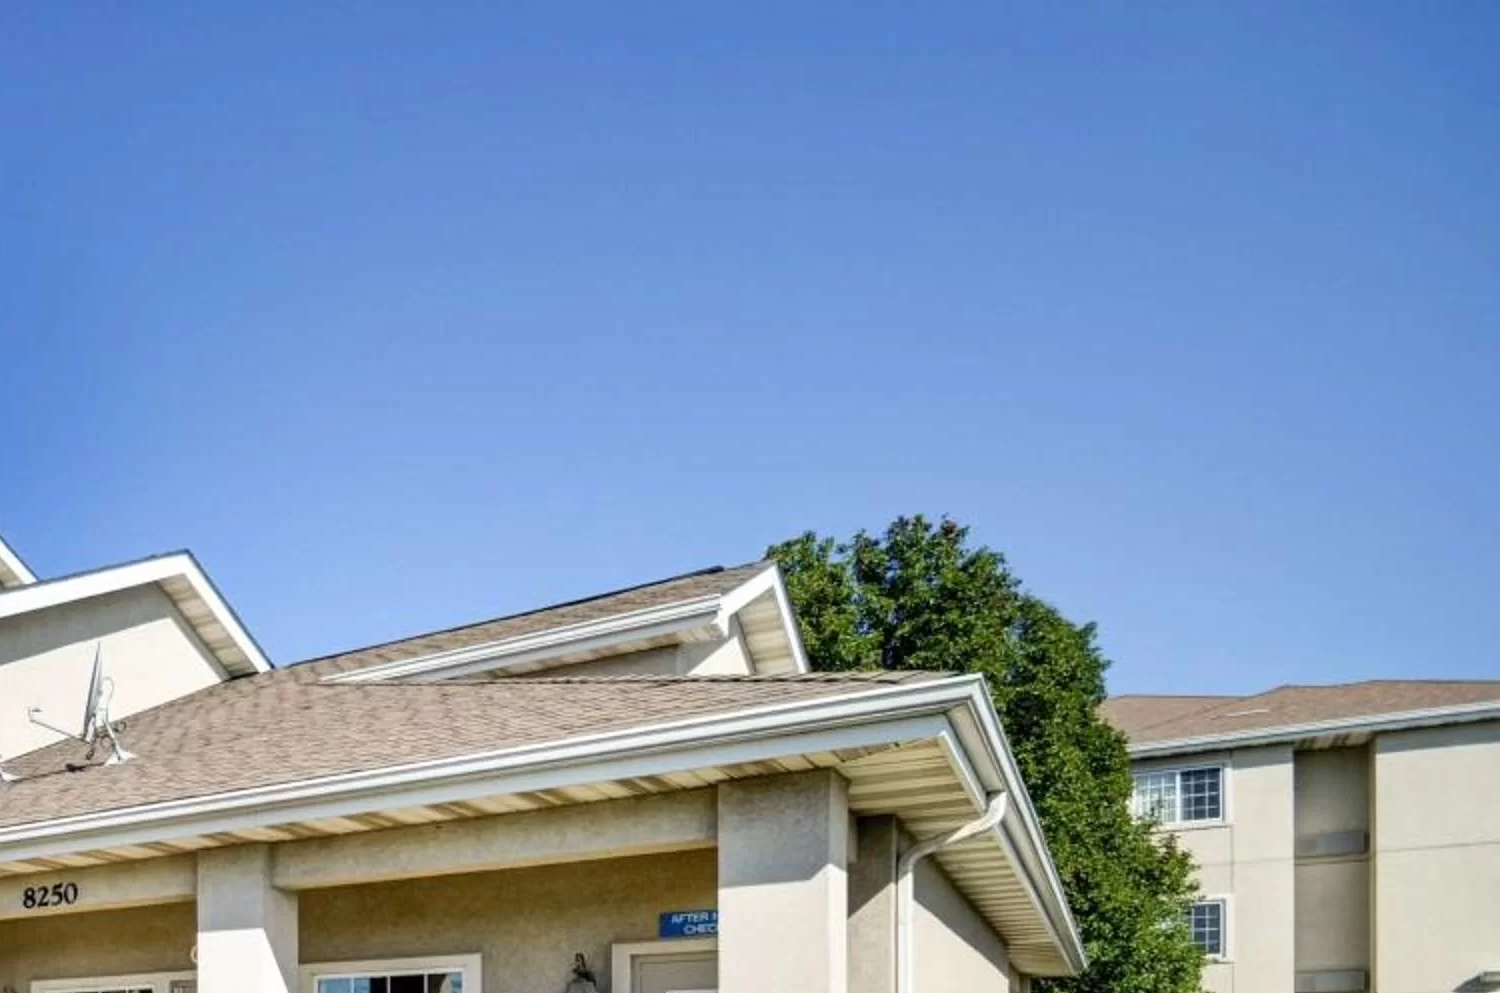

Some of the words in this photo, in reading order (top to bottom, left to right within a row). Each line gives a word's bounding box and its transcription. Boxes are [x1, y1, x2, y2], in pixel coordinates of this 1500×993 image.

[23, 882, 78, 909] 8250
[671, 912, 709, 924] AFTER
[683, 924, 718, 935] CHEC
